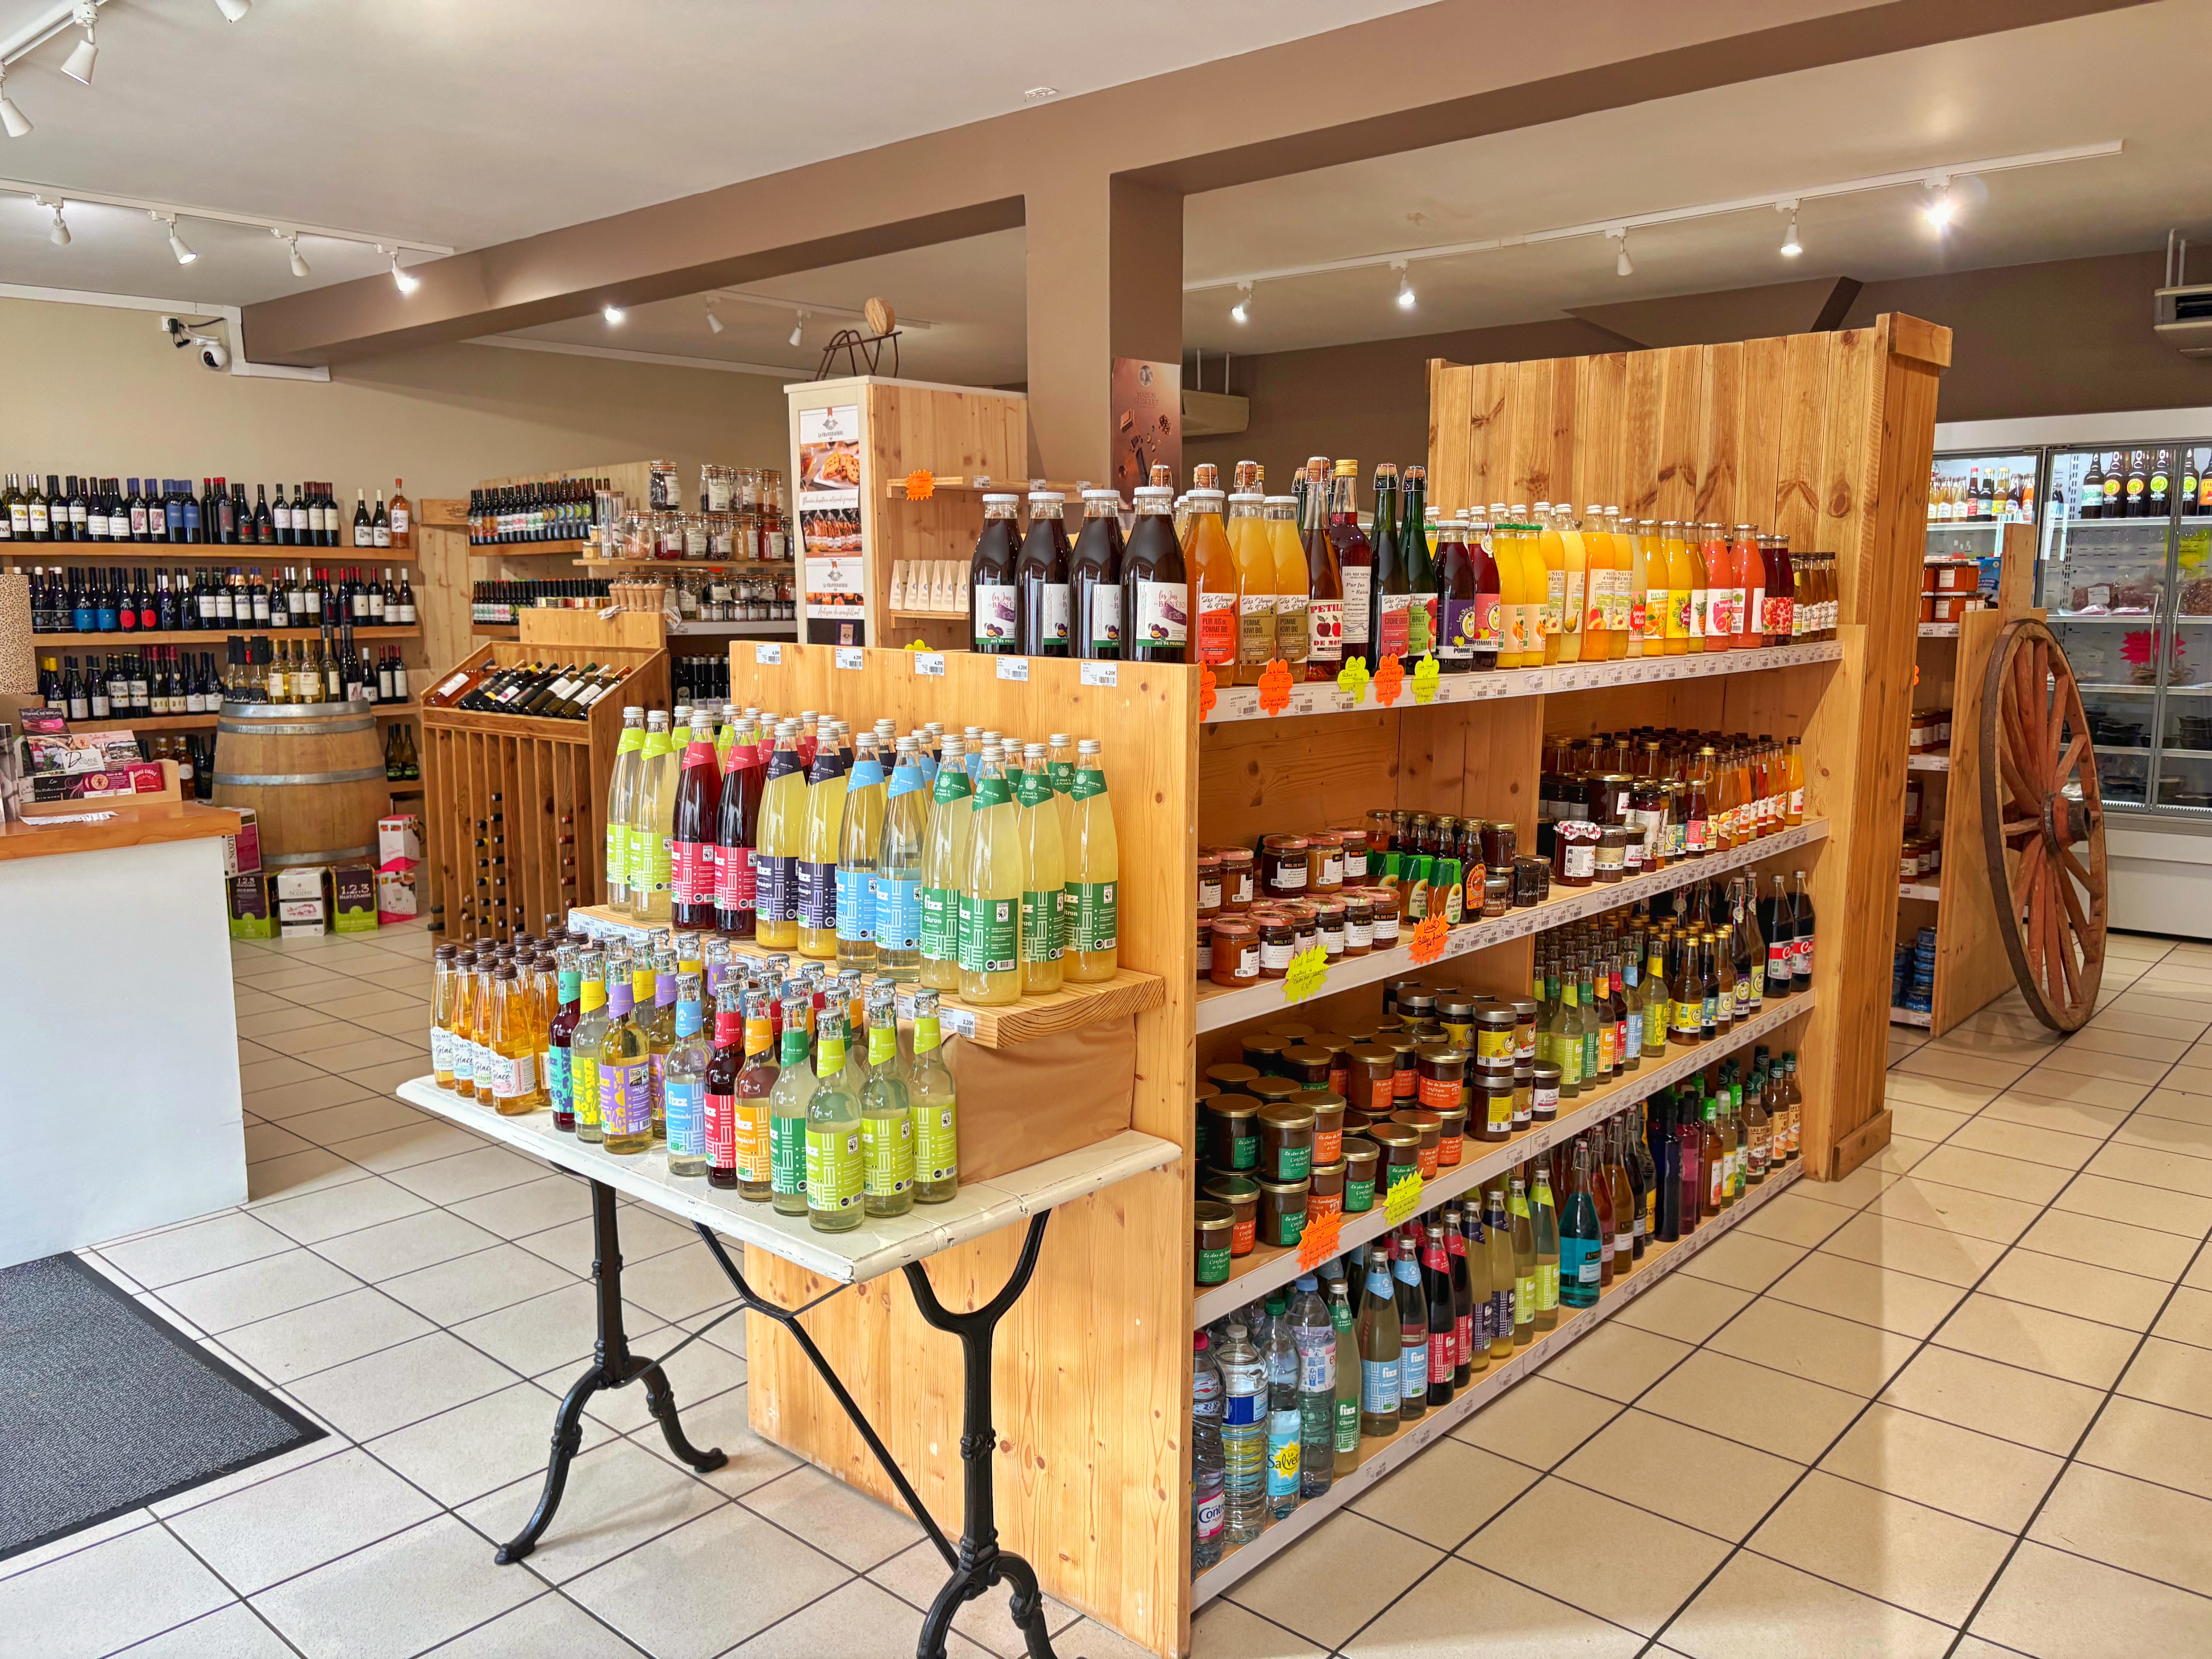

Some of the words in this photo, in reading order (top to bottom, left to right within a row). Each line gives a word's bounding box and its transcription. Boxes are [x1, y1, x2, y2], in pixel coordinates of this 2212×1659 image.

[1001, 592, 1012, 602] Jus
[1168, 590, 1178, 601] Jus
[340, 883, 370, 895] 1.2.3
[924, 894, 943, 911] fizz
[924, 915, 942, 924] Citron
[668, 1090, 688, 1107] fizz
[1411, 1352, 1425, 1363] fizz
[1382, 1367, 1398, 1378] fizz
[1340, 1404, 1356, 1416] fizz
